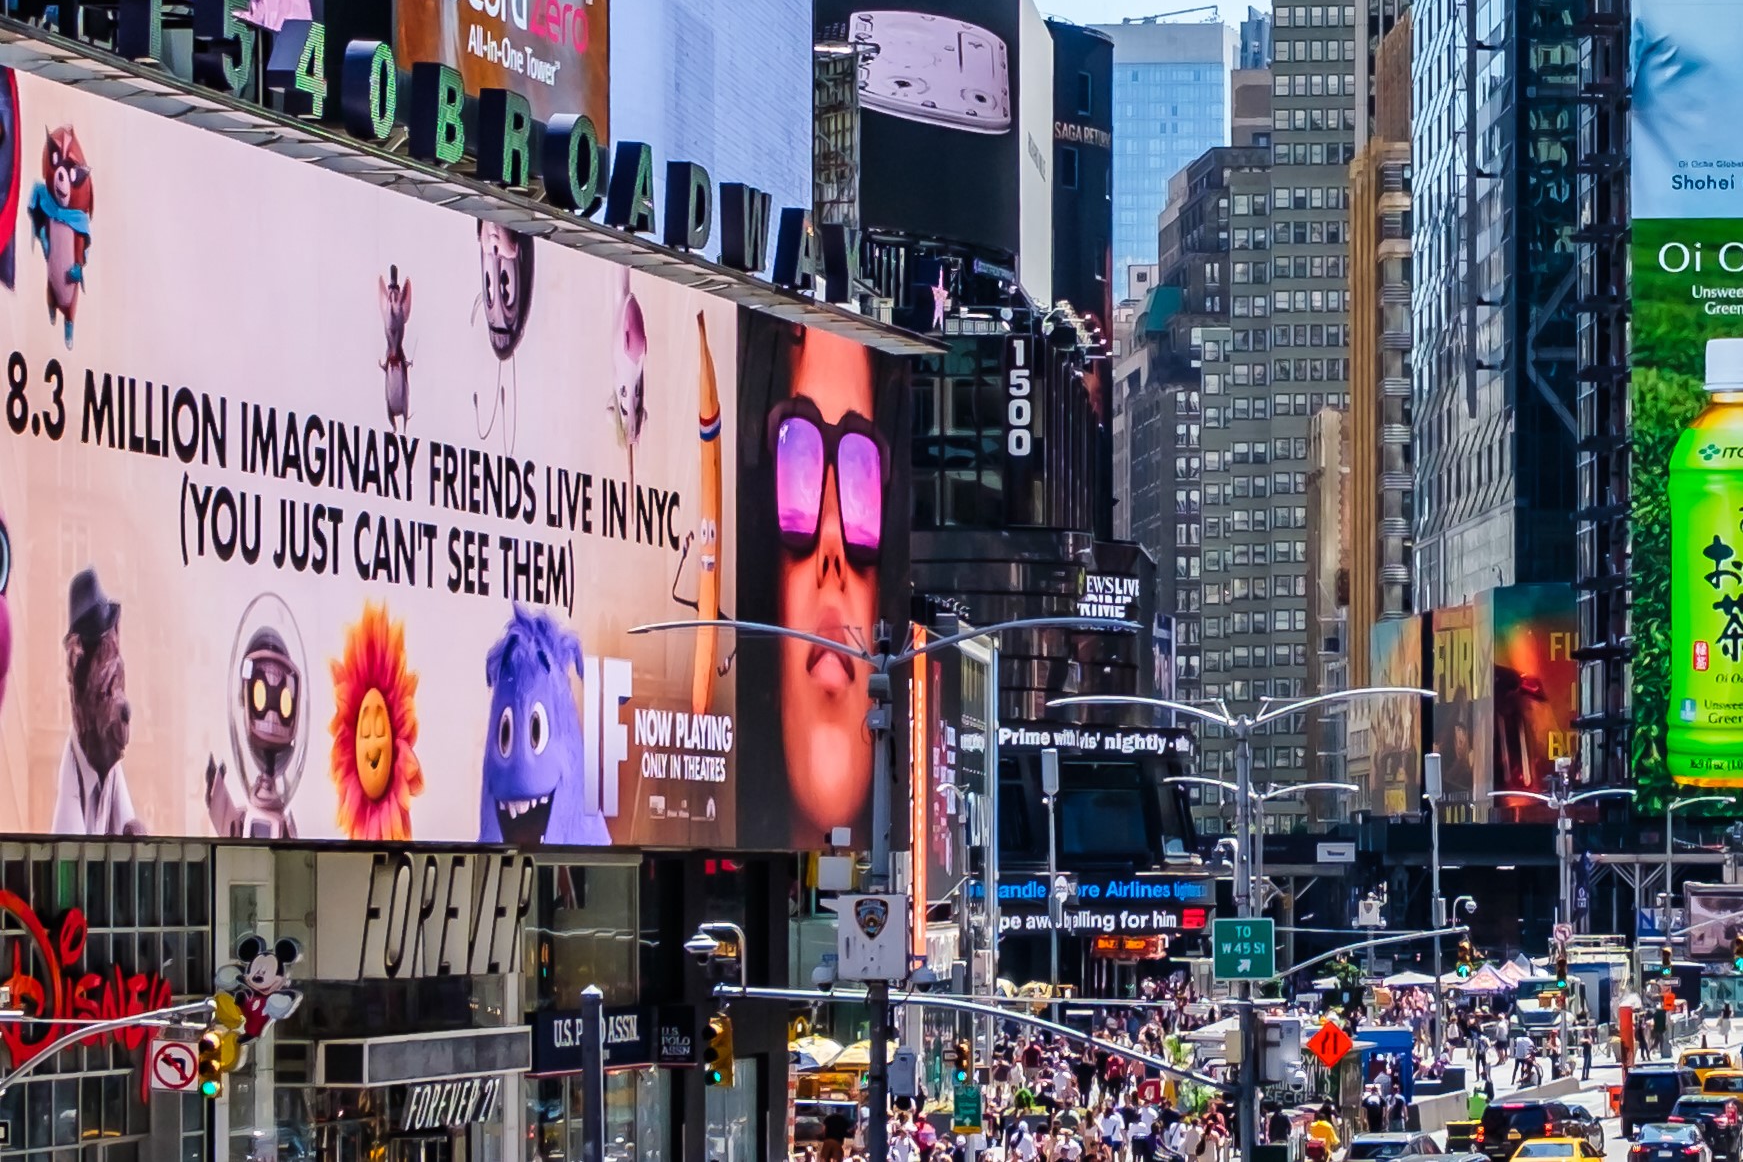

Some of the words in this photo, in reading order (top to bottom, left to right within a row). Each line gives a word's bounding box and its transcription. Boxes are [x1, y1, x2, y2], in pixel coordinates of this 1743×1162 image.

[467, 24, 524, 75] All-In-One
[414, 62, 862, 304] BROADWAY
[1672, 173, 1735, 190] Shohei
[1658, 242, 1702, 273] Oi
[6, 351, 66, 441] 8.3
[81, 368, 227, 468] MILLION
[241, 401, 420, 502] IMAGINARY
[429, 440, 536, 525] FRIENDS
[546, 465, 593, 534] LIVE
[602, 477, 627, 540] IN
[636, 484, 681, 551] NYC
[180, 471, 262, 567] (YOU
[273, 498, 344, 575] JUST
[354, 510, 438, 590] CAN'T
[447, 526, 490, 596] SEE
[499, 536, 575, 619] THEM)
[584, 656, 632, 817] IF
[634, 708, 673, 748] NOW
[676, 713, 733, 753] PLAYING
[642, 751, 668, 779] ONLY
[670, 755, 681, 780] IN
[683, 755, 726, 782] THEATRES
[1105, 881, 1170, 899] Airlines
[359, 852, 535, 979] FOREVER
[1119, 908, 1149, 929] for
[1235, 925, 1251, 939] TO
[1221, 942, 1232, 955] W
[1233, 942, 1252, 955] 45
[405, 1079, 482, 1132] FOREVER
[479, 1078, 500, 1122] 21
